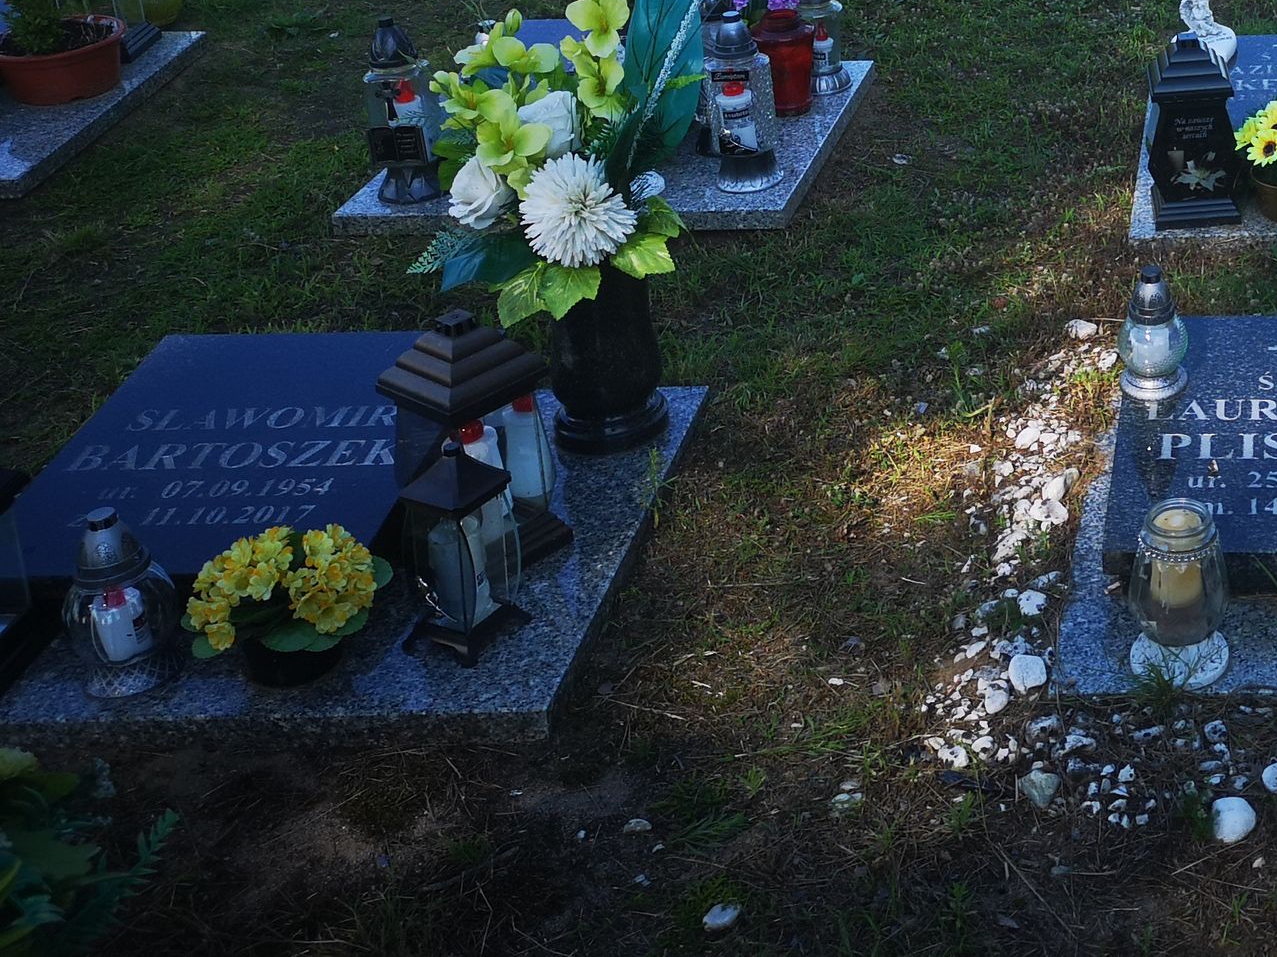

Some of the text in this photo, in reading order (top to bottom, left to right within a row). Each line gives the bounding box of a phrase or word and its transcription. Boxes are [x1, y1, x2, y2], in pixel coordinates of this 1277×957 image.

[1258, 371, 1275, 391] Ś
[63, 439, 398, 472] BARTOSZEK
[161, 477, 335, 500] 07.09.1954
[1187, 472, 1226, 489] ur.
[140, 505, 317, 528] 11.10.2017
